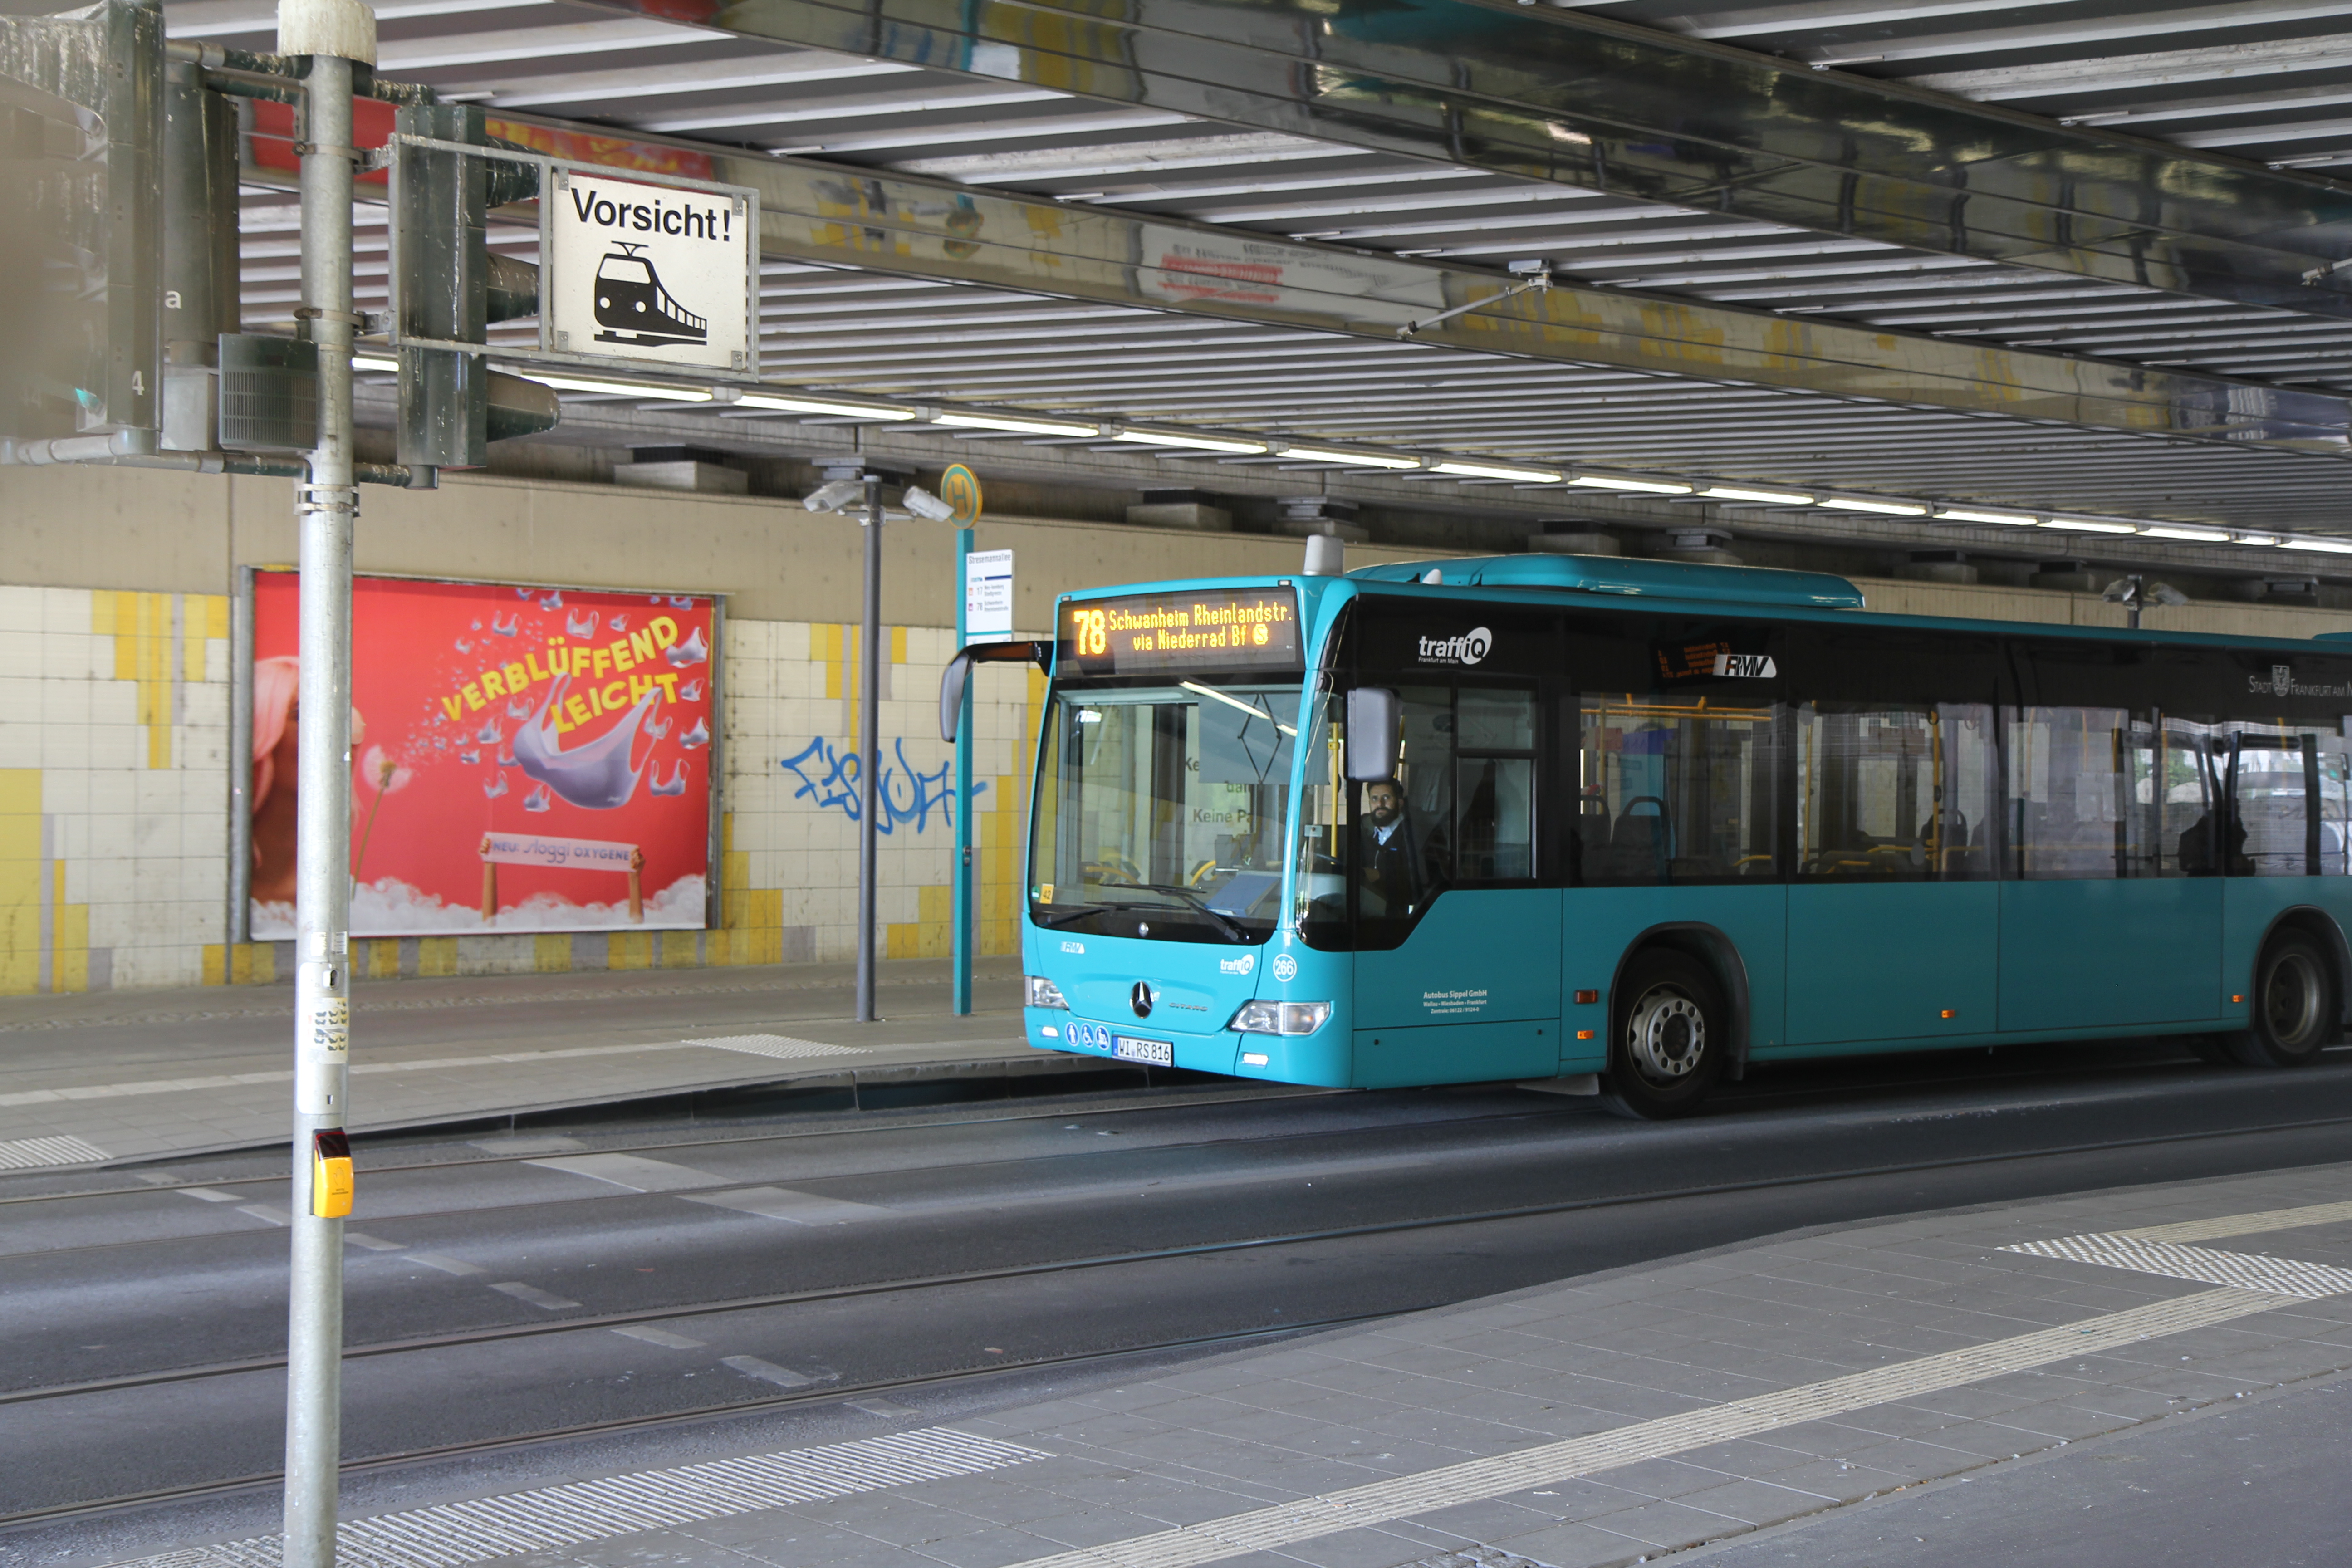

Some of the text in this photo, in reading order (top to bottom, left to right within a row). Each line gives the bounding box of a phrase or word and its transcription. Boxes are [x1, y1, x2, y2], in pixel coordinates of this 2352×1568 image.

[571, 187, 730, 241] Vorsicht!
[132, 370, 145, 395] 4
[951, 480, 968, 514] H
[968, 553, 1011, 564] Stresemannallee
[977, 587, 983, 596] 17
[977, 602, 983, 611] 78
[1108, 600, 1293, 631] Schwanheim Rheinlandstr.
[1073, 609, 1106, 655] 78
[1132, 633, 1153, 651] via
[1157, 626, 1226, 650] Niederrad
[1231, 625, 1247, 647] Bf
[441, 616, 679, 721] VERBLÜFFEND
[550, 672, 679, 735] LEICHT
[1193, 808, 1233, 823] Keine
[573, 846, 630, 861] OXYGENE
[1275, 960, 1294, 975] 266
[1449, 990, 1468, 1000] Sippel
[1169, 1002, 1209, 1011] CITARO
[1119, 1039, 1170, 1061] WI RS 816
